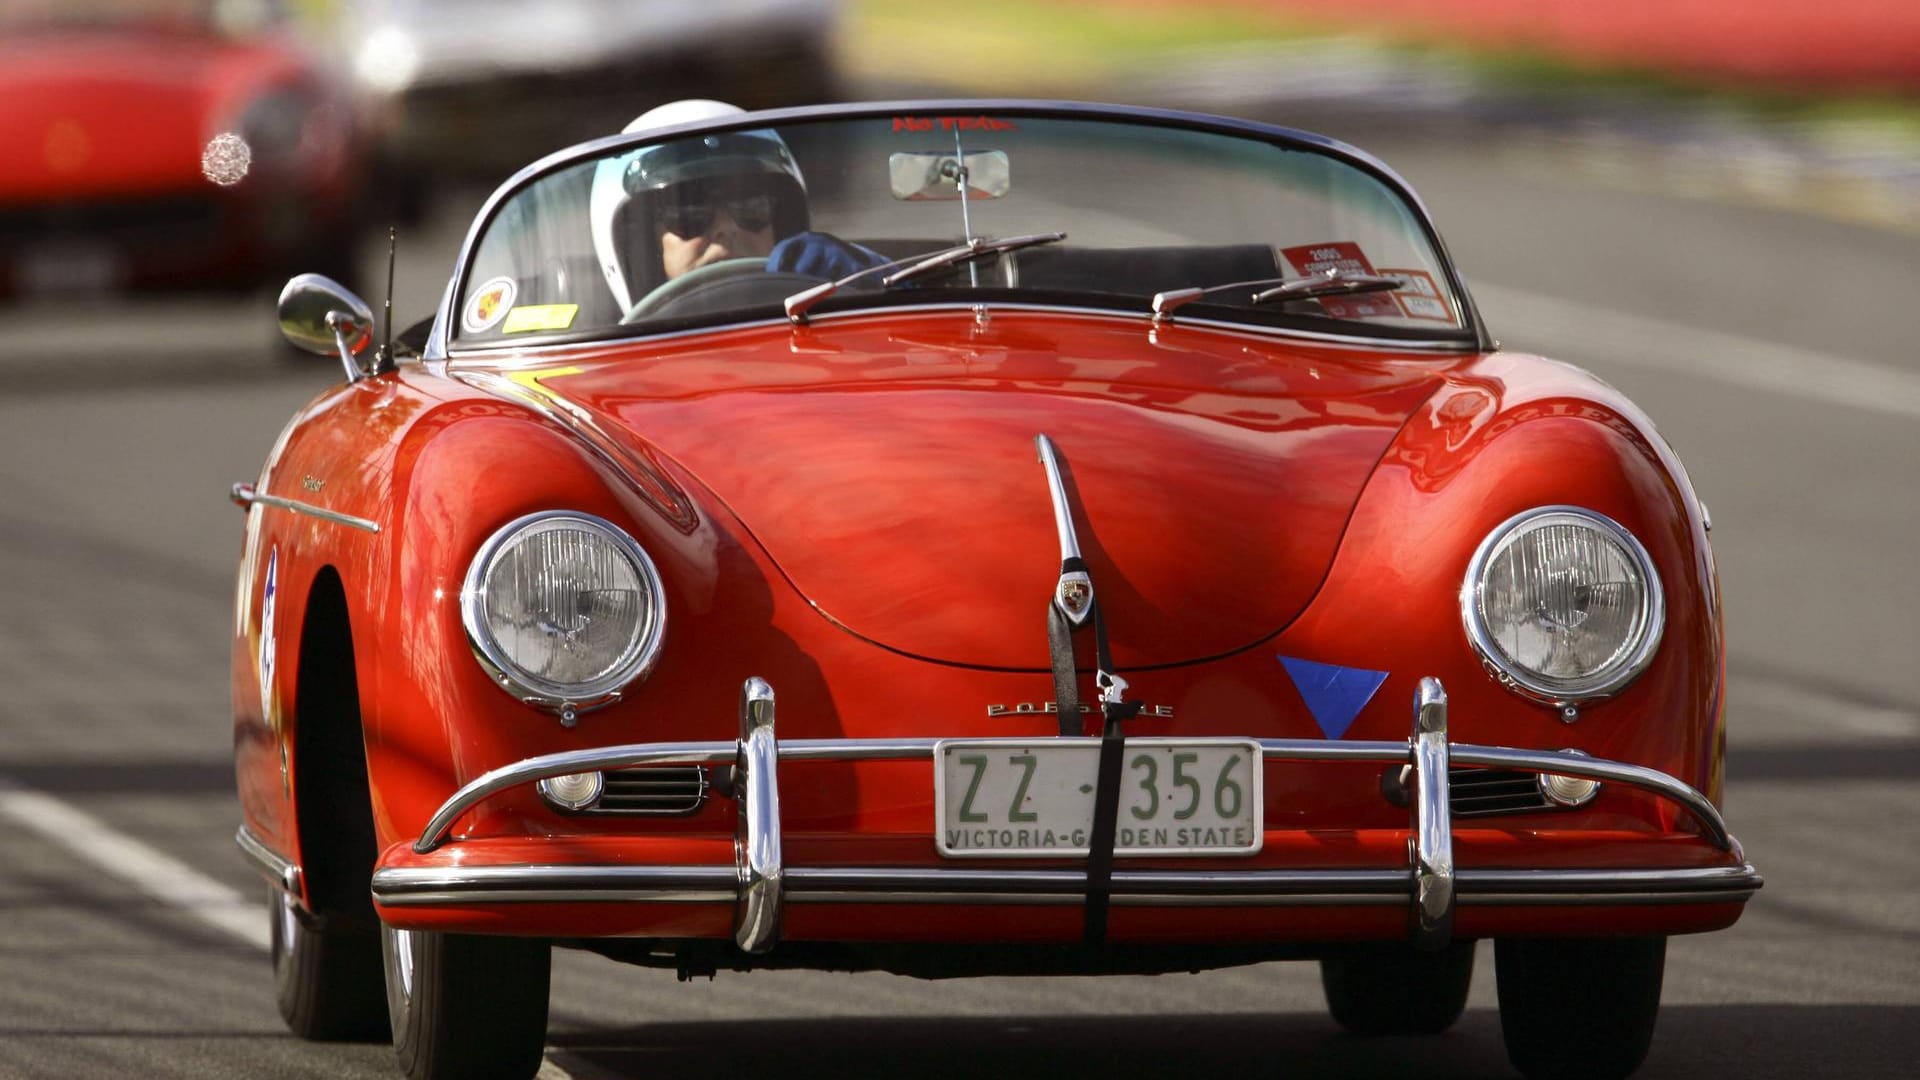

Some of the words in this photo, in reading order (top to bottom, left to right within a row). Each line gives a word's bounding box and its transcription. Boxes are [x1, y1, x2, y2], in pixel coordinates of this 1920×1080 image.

[987, 701, 1174, 717] PORSE
[959, 754, 1038, 823] ZZ
[1130, 754, 1242, 821] 356
[949, 828, 1168, 848] VICTORIA-GDEN
[1176, 828, 1246, 846] STATE
